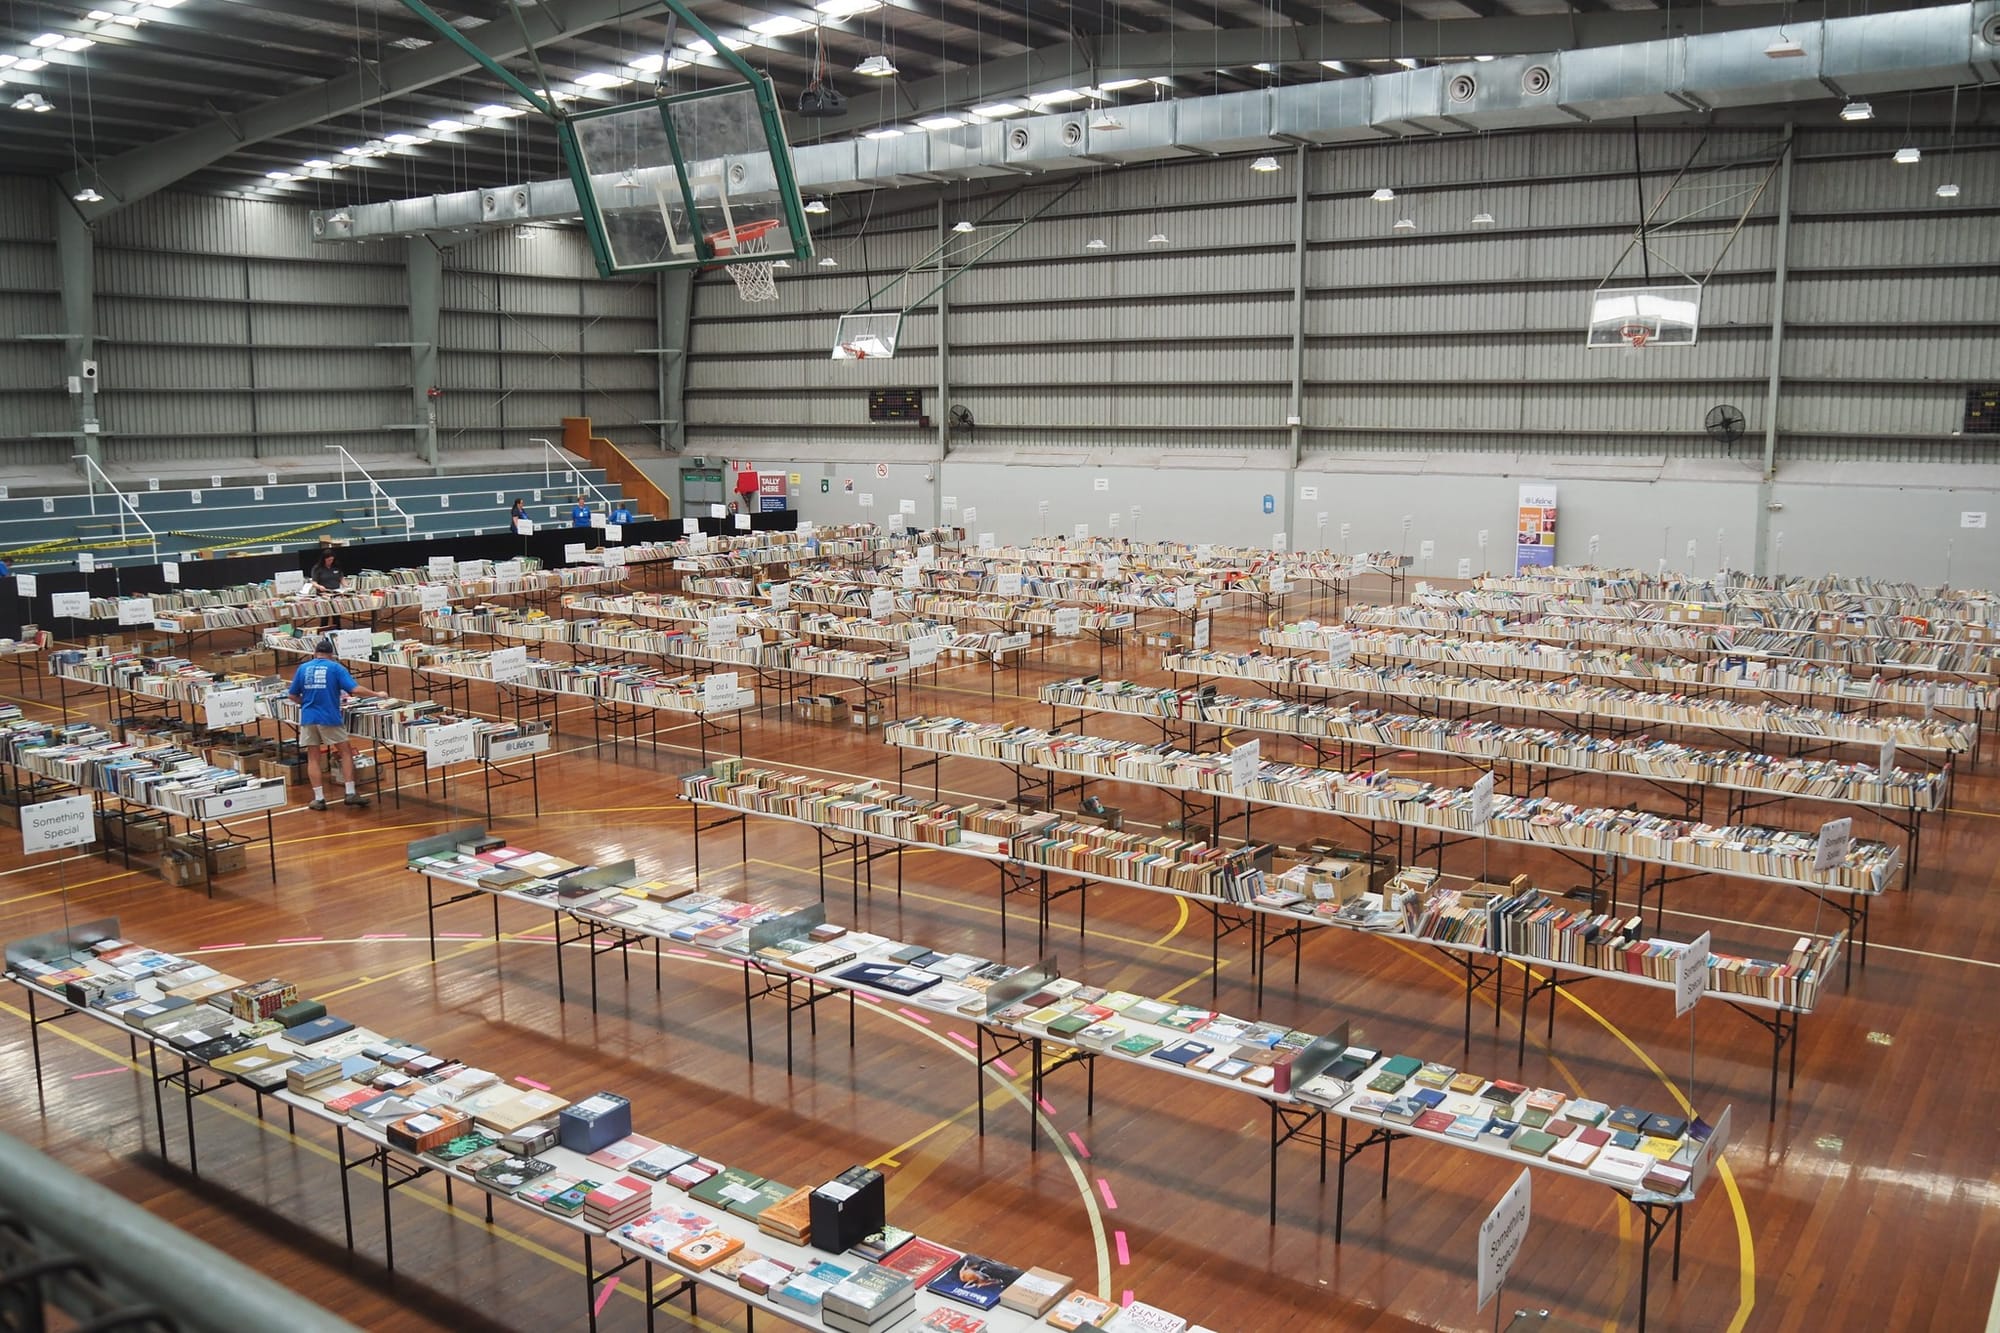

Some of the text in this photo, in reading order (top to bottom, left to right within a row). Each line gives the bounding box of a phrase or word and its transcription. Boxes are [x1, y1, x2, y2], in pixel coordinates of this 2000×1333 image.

[1532, 496, 1553, 505] Lifeline
[715, 683, 725, 691] Old
[711, 692, 734, 701] Interesting
[219, 700, 244, 710] Military
[434, 734, 468, 747] Something
[512, 738, 534, 750] Lifeline
[441, 745, 464, 757] Special
[33, 811, 85, 828] Something
[43, 825, 80, 840] Special
[1683, 955, 1706, 980] Something
[1490, 1205, 1526, 1258] Something
[1496, 1231, 1520, 1274] Special
[1127, 1310, 1177, 1333] TROPICAL
[1130, 1304, 1180, 1328] PLANTS
